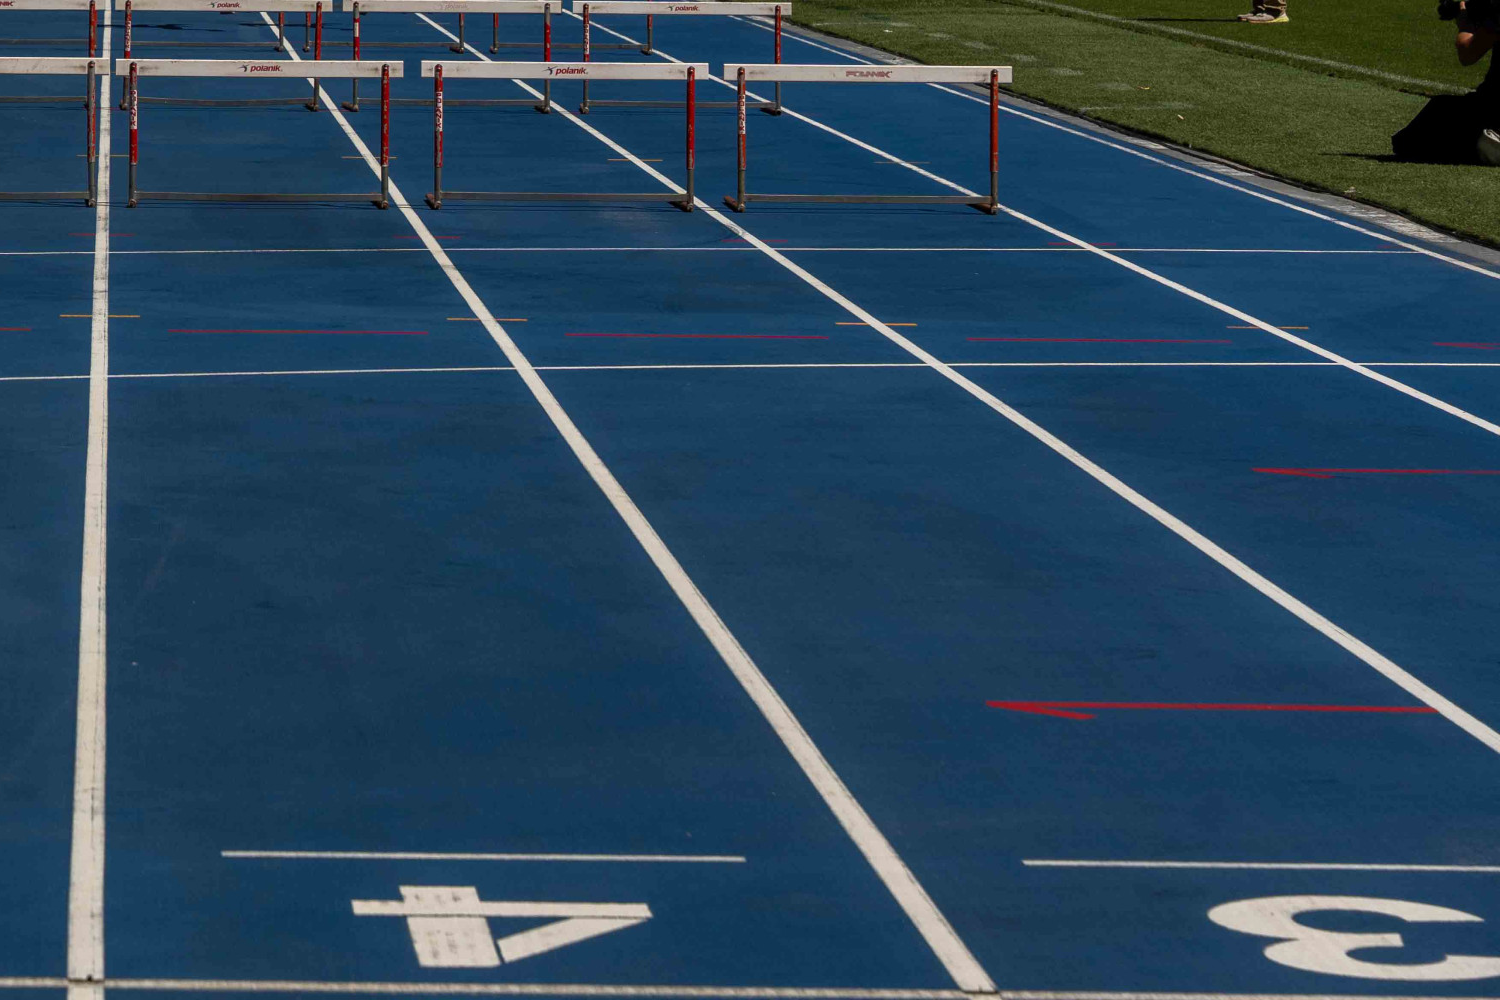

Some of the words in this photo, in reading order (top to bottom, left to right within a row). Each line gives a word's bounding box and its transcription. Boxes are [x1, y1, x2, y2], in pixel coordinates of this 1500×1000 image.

[250, 65, 281, 73] polanik
[555, 67, 587, 75] polanik
[351, 884, 652, 968] 4
[1207, 893, 1500, 981] 3
